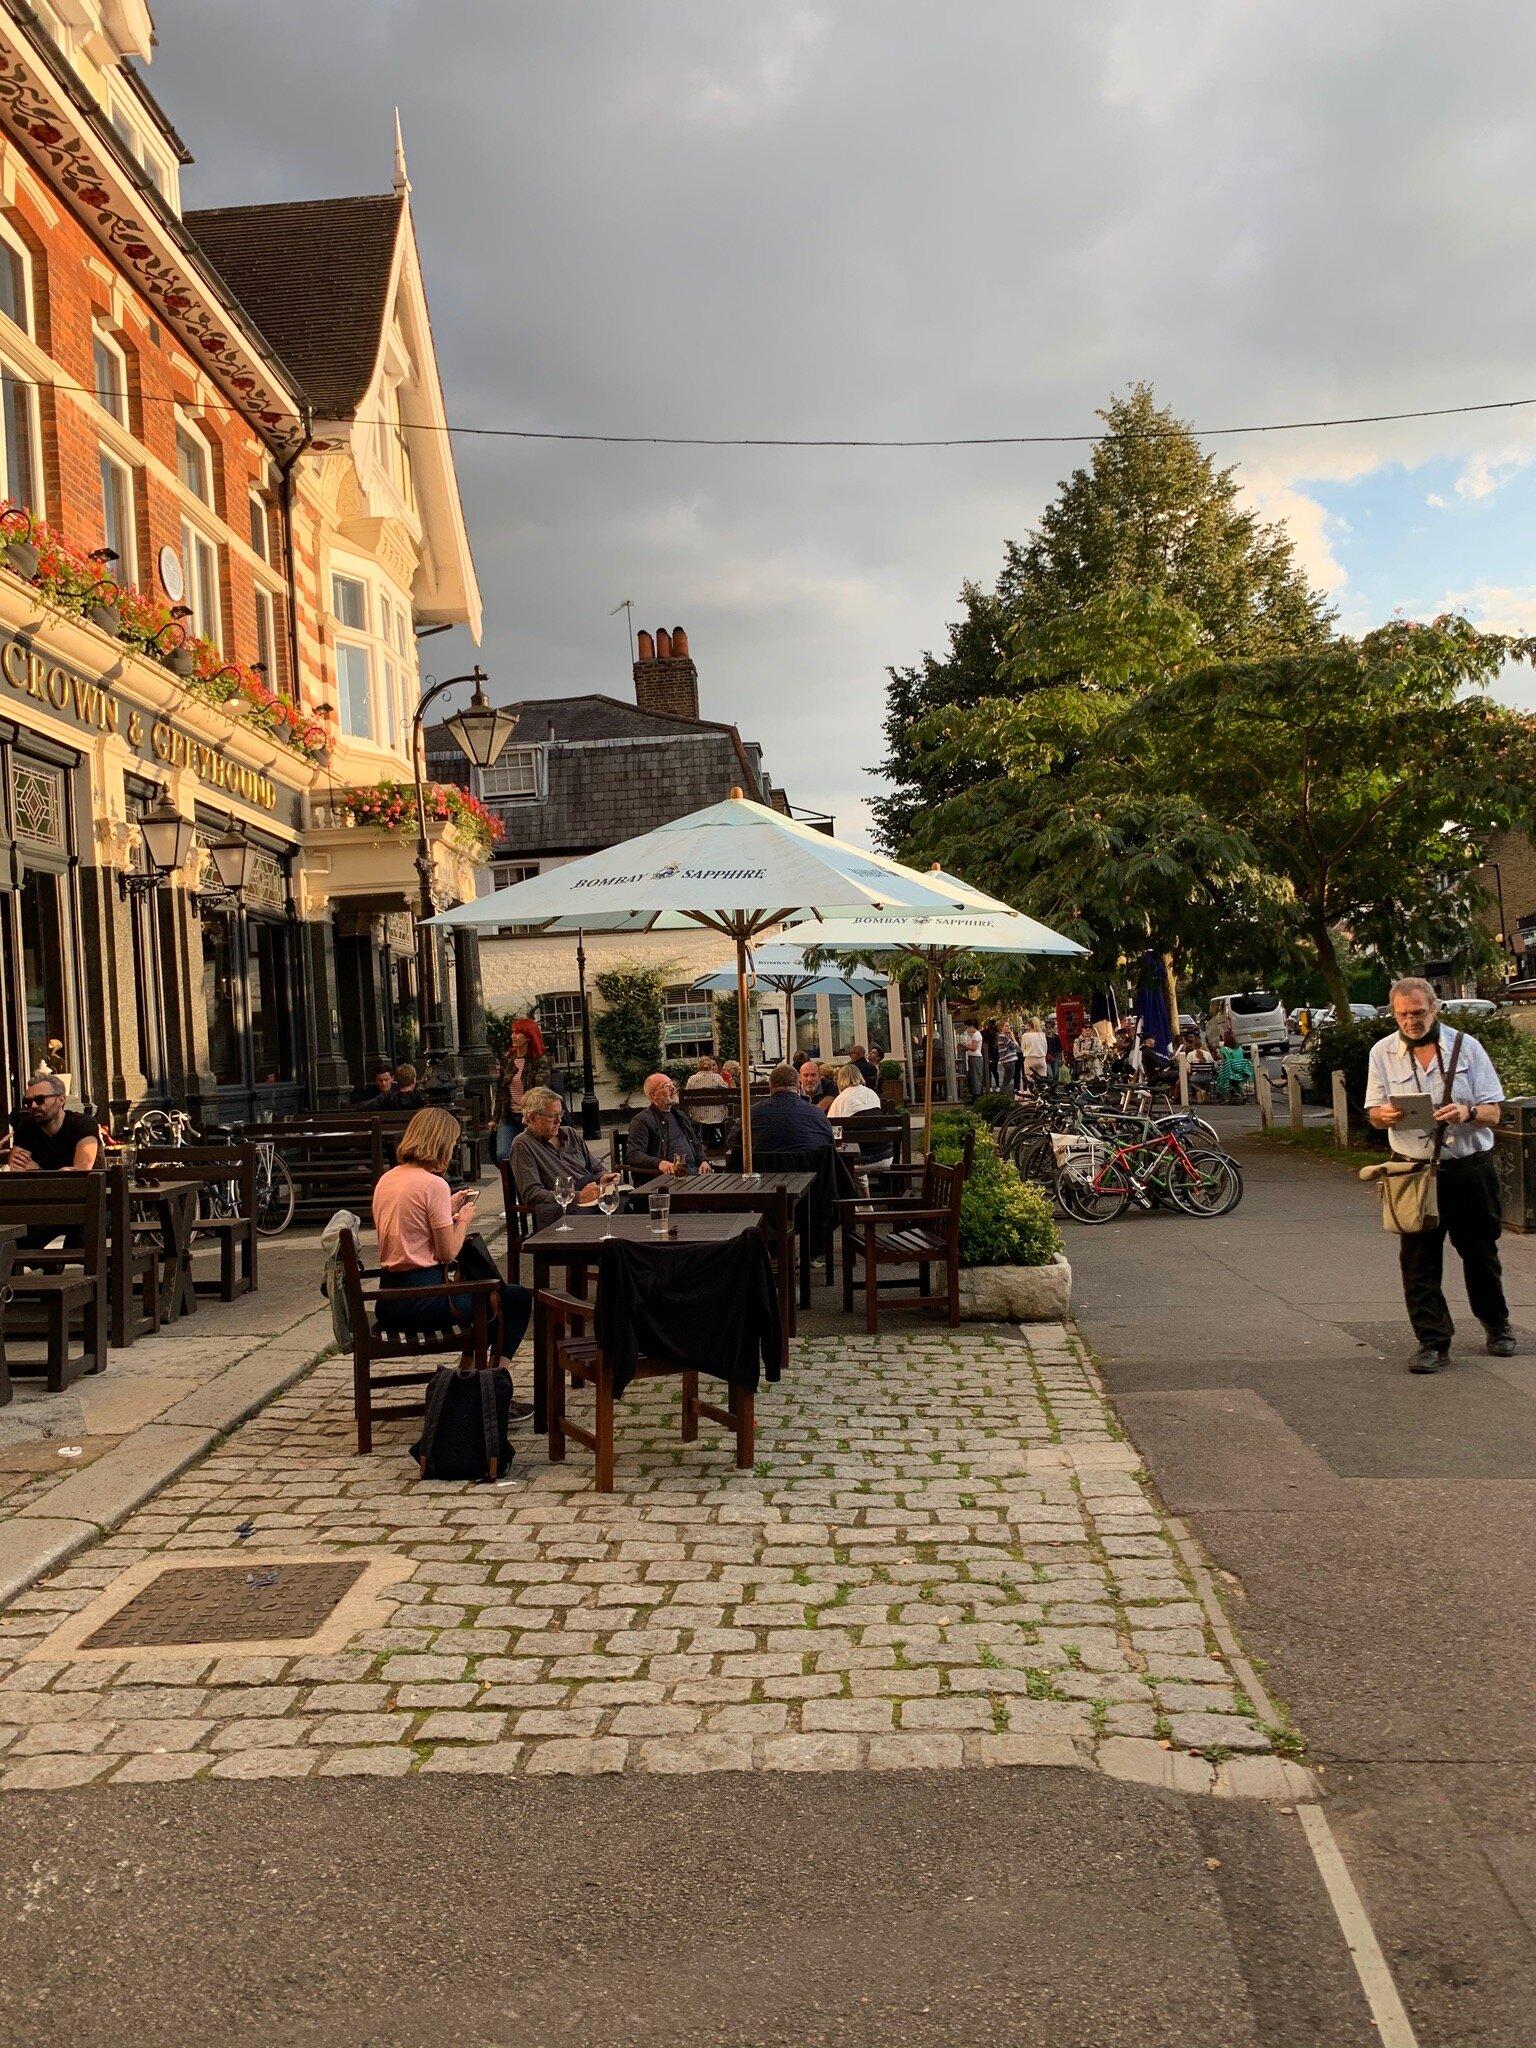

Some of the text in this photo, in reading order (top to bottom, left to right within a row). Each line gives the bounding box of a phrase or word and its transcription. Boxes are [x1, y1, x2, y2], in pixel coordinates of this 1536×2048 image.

[2, 642, 276, 812] CROWN & GREYHOUND
[570, 868, 767, 890] BOMBAY SAPPHIRE
[853, 917, 995, 928] BOMBAY SAPPHIRE
